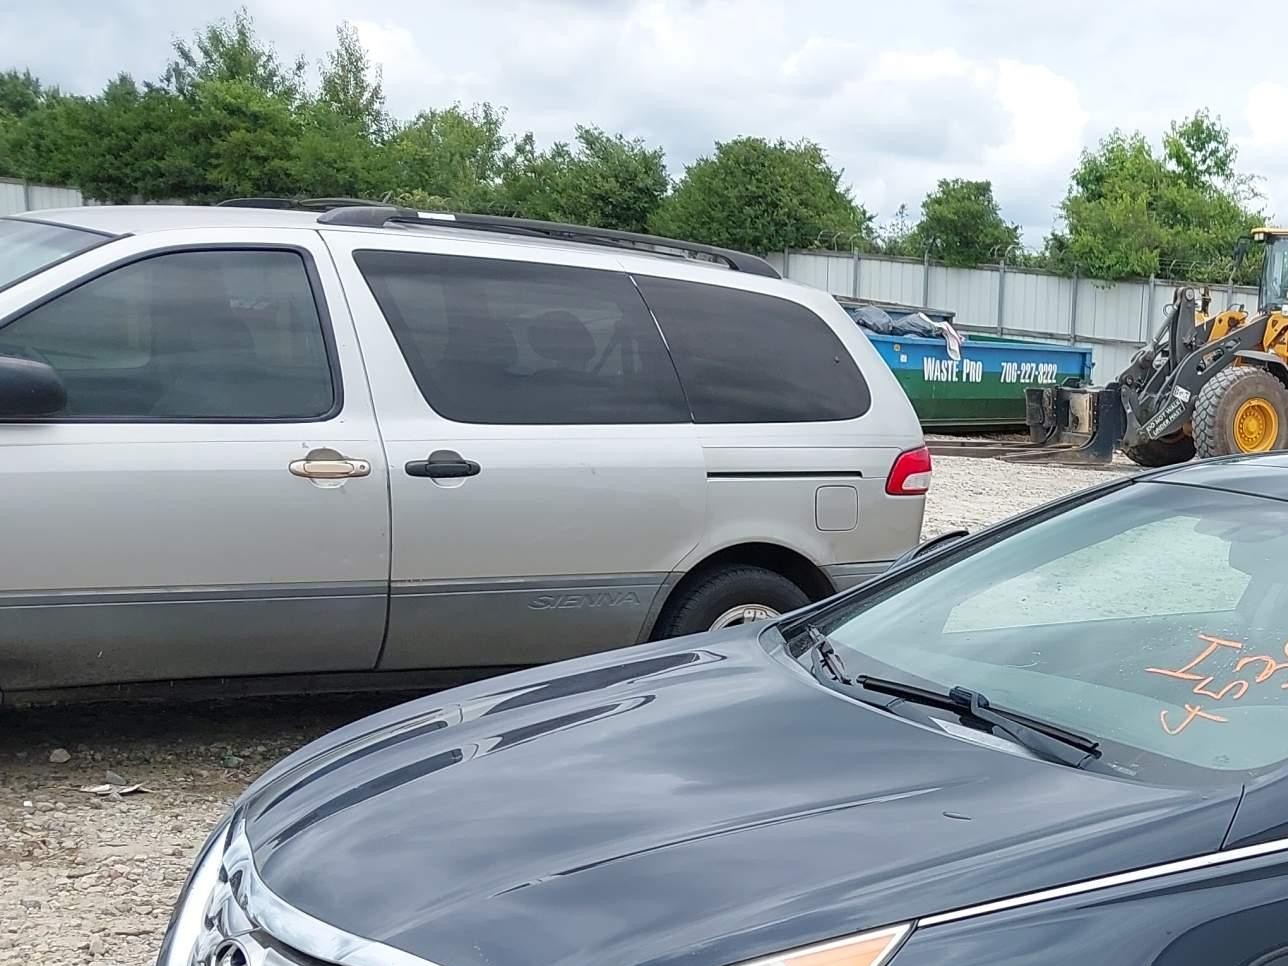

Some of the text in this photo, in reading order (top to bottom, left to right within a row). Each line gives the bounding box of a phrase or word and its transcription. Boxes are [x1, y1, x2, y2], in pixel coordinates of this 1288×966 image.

[923, 356, 959, 382] WASTE
[962, 358, 983, 383] PRO
[1146, 399, 1181, 432] DO NOT WALK
[1153, 420, 1171, 436] UNDER
[528, 591, 641, 610] SIENNA
